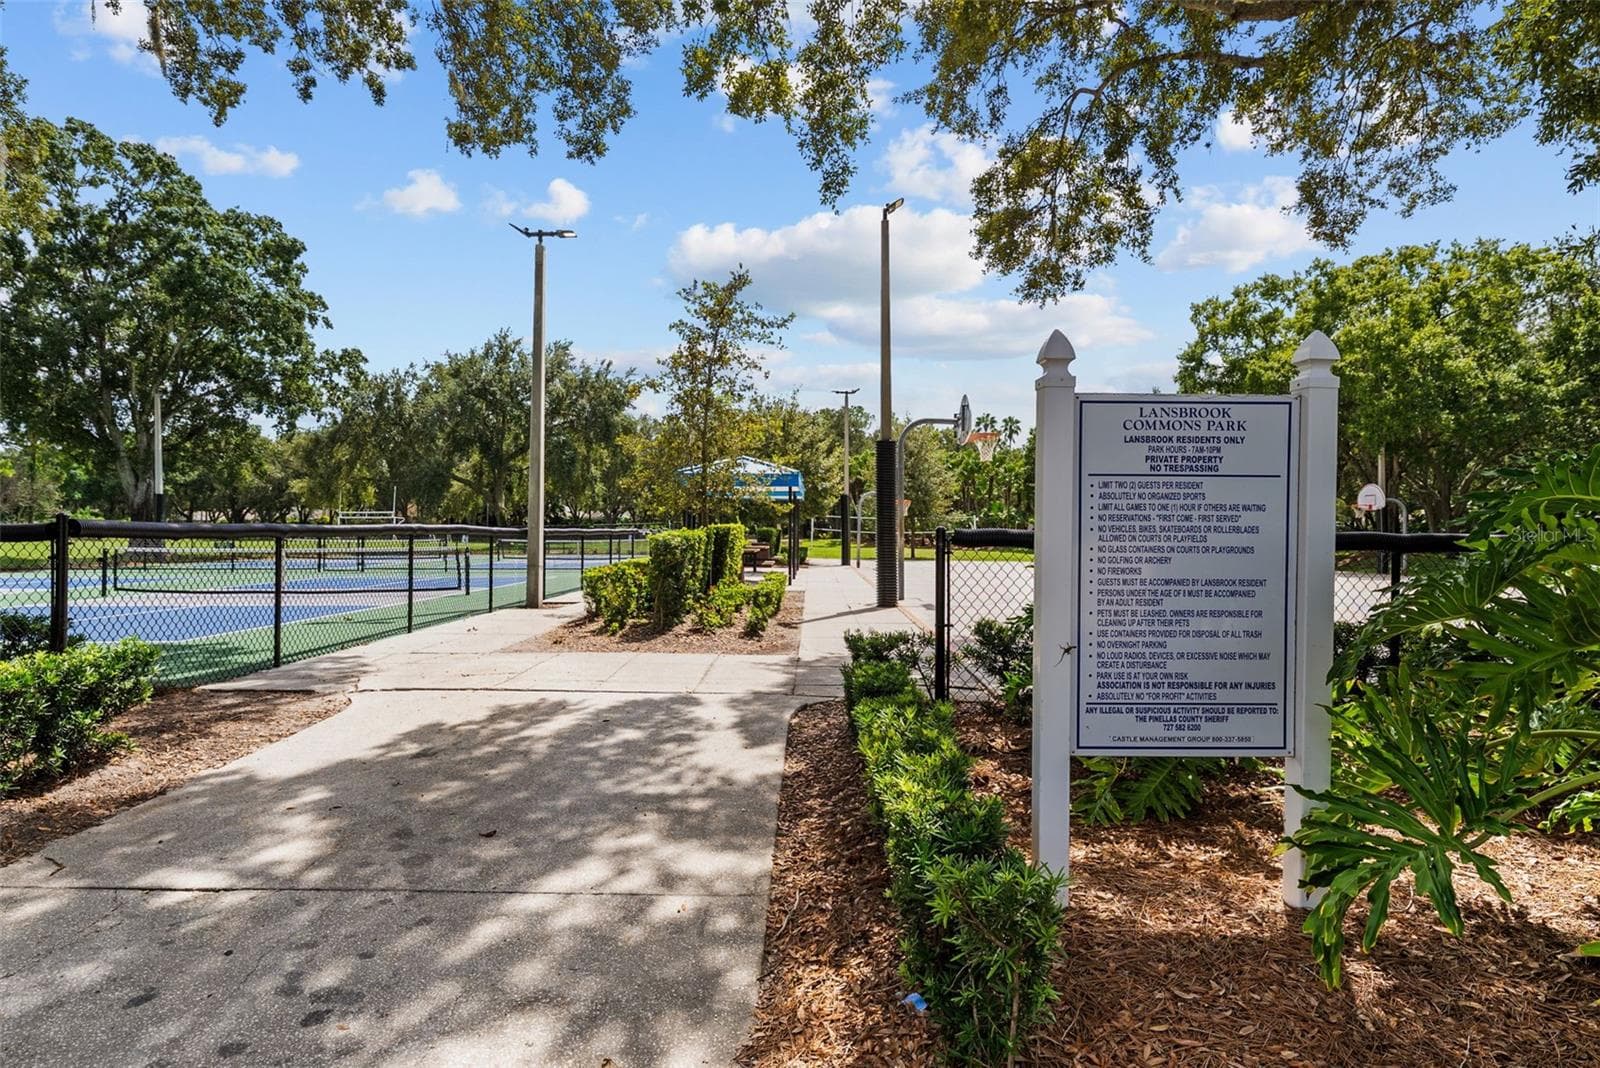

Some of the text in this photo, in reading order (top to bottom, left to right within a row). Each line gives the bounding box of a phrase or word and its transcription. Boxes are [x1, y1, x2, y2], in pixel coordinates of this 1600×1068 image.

[1138, 407, 1232, 418] LANSBROOK
[1122, 419, 1248, 431] COMMONS PARK
[1124, 436, 1246, 444] LANSBROOK RESIDENTS ONLY
[1148, 445, 1164, 453] PARK
[1166, 445, 1188, 453] HOURS
[1144, 455, 1224, 463] PRIVATE PROPERTY
[1150, 464, 1220, 472] NO TRESPASSING
[1098, 481, 1204, 489] LIMIT TWO GUESTS PER RESIDENT
[1098, 492, 1206, 500] ABSOLUTELY NO ORGANIZED SPORTS
[1098, 503, 1266, 512] LIMIT ALL GAMES TO ONE HOUR IF OTHERS ARE WAITING
[1098, 514, 1242, 522] NO RESERVATIONS "FIRST COME FIRST SERVED"
[1098, 525, 1260, 534] NO SKATEBOARDS OR ROLLERBLADES
[1098, 534, 1208, 542] ALLOWED ON COURTS OR PLAYFIELDS
[1098, 545, 1255, 554] NO GLASS CONTAINERS ON COURTS OR PLAYGROUNDS
[1098, 556, 1172, 564] NO GOLFING OR ARCHERY
[1097, 567, 1142, 575] NO FIREWORKS
[1097, 578, 1268, 587] GUESTS MUST BE ACCOMPANIED BY LANSBROOK RESIDENT
[1097, 589, 1256, 598] PERSONS UNDER THE AGE OF MUST BE ACCOMPANIED
[1096, 630, 1262, 638] USE CONTAINERS PROVIDED FOR DISPOSAL OF ALL TRASH
[1096, 652, 1272, 660] NO LOUD OR EXCESSIVE NOISE WHICH MAY
[1096, 661, 1168, 669] CREATE A DISTURBANCE
[1096, 672, 1188, 680] PARK USE IS AT YOUR OWN RISK
[1096, 692, 1217, 700] ABSOLUTELY NO "FOR PROFIT" ACTIVITIES
